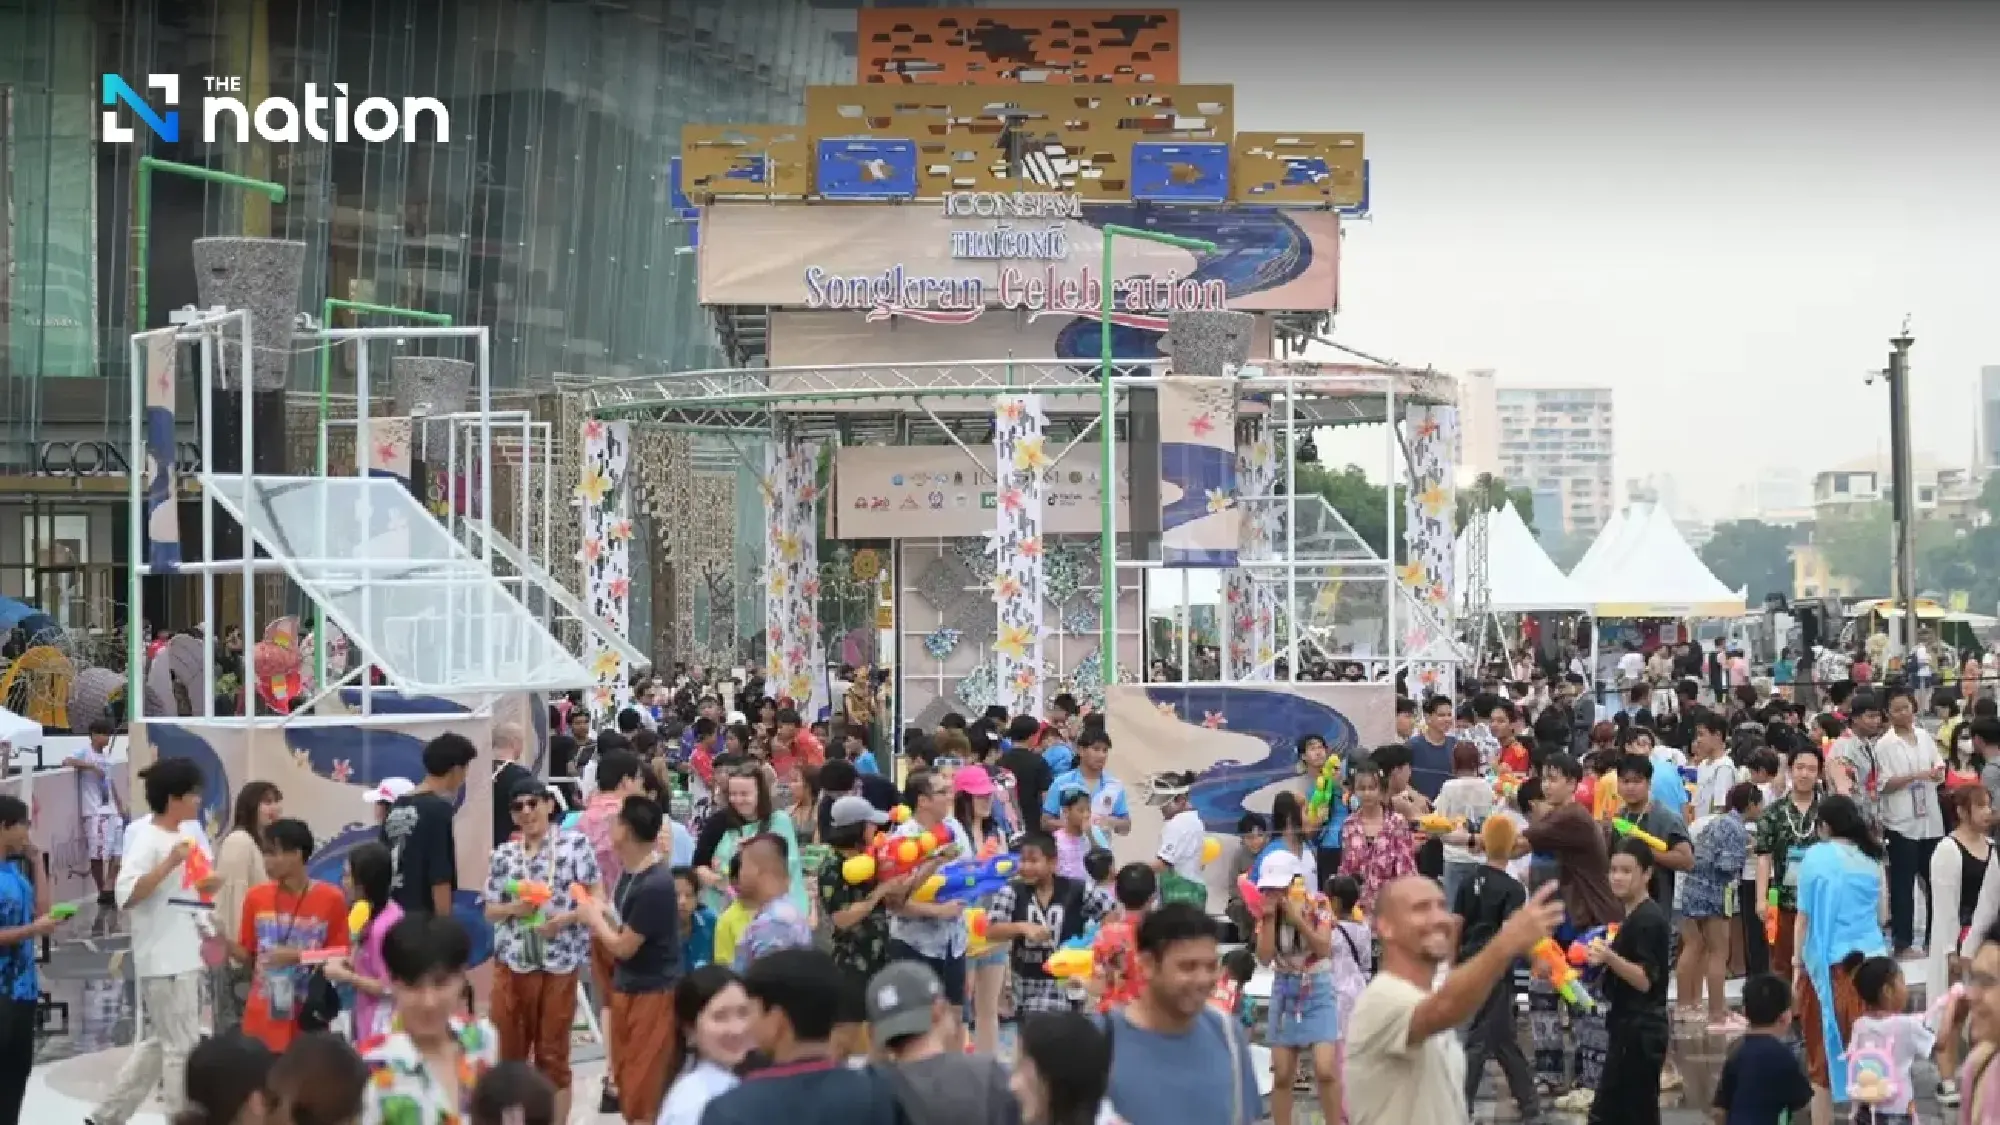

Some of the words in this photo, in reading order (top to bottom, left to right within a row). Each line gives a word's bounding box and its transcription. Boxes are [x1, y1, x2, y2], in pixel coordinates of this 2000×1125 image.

[942, 191, 1084, 217] ICONSIAM
[805, 263, 984, 320] Songkran
[1001, 264, 1228, 313] Celebration
